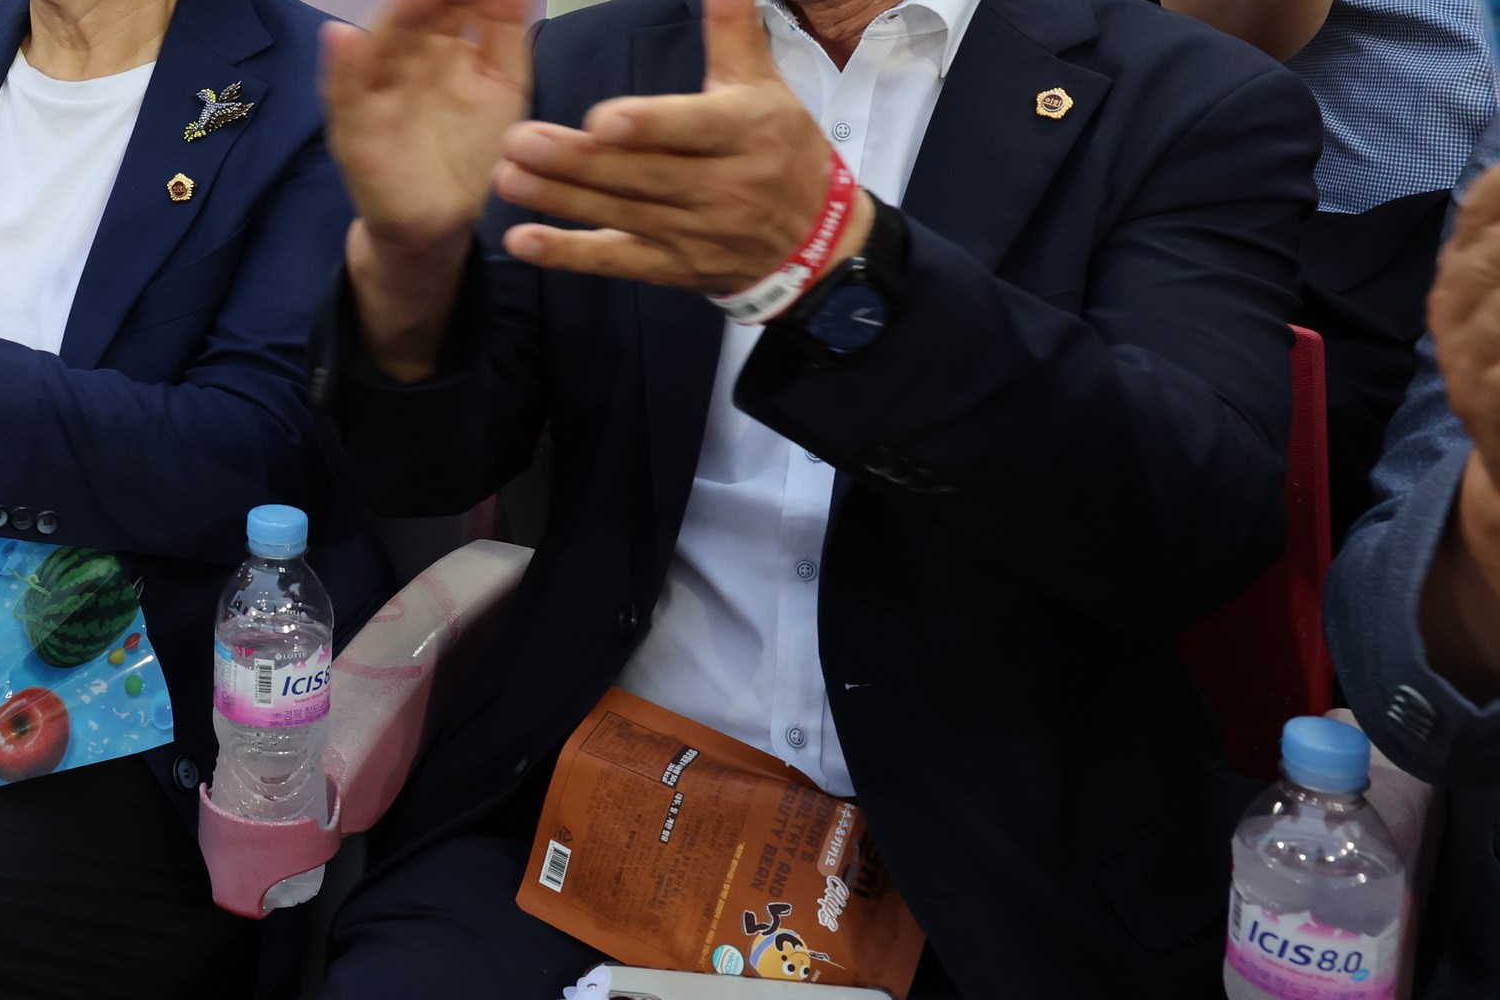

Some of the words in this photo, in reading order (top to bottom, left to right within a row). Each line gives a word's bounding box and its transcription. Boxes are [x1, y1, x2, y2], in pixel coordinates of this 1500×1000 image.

[282, 670, 324, 696] ICIS
[817, 875, 849, 932] Chips
[1248, 921, 1315, 967] ICIS
